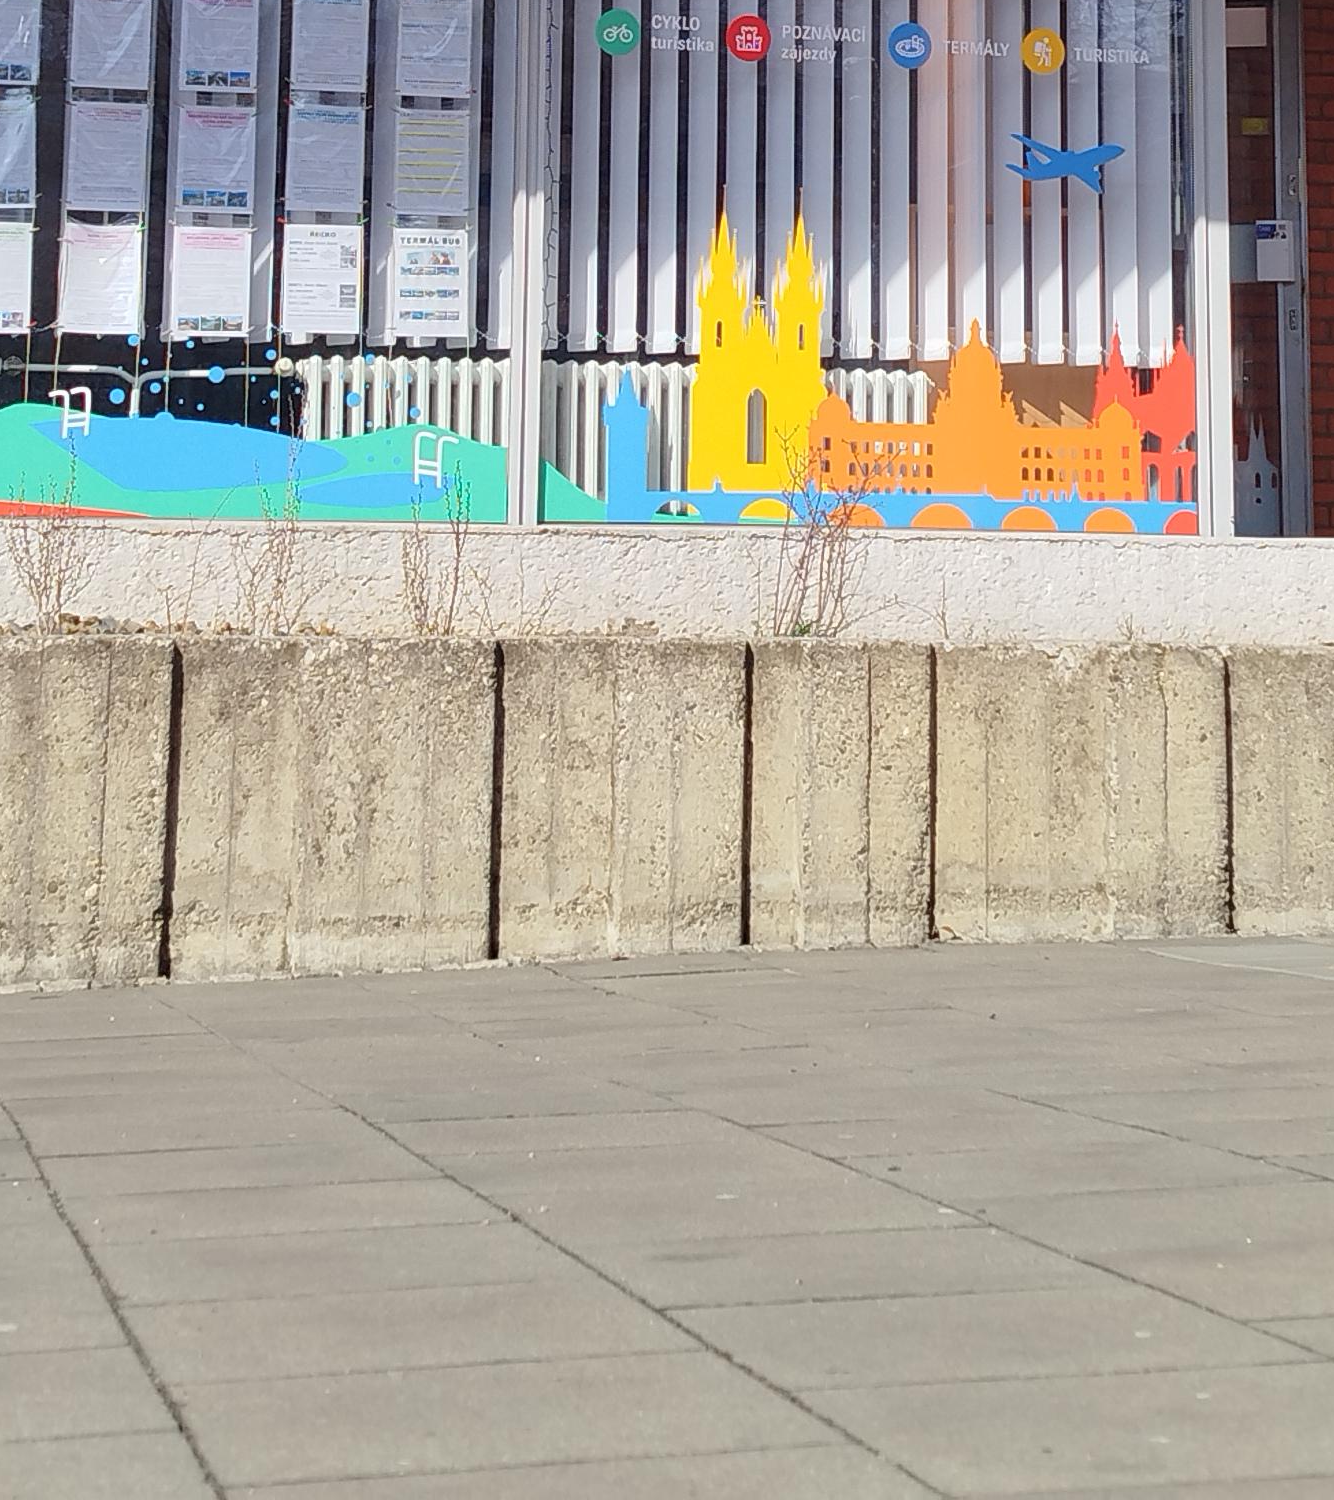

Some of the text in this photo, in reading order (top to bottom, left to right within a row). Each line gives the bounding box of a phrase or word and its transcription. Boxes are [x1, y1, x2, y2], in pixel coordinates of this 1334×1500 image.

[651, 13, 701, 33] CYKLO
[781, 22, 867, 44] POZNÁVACÍ
[651, 34, 715, 53] turistika
[942, 37, 1011, 58] TERMÁLY
[780, 44, 838, 65] zájezdy
[1074, 47, 1151, 65] TURISTIKA
